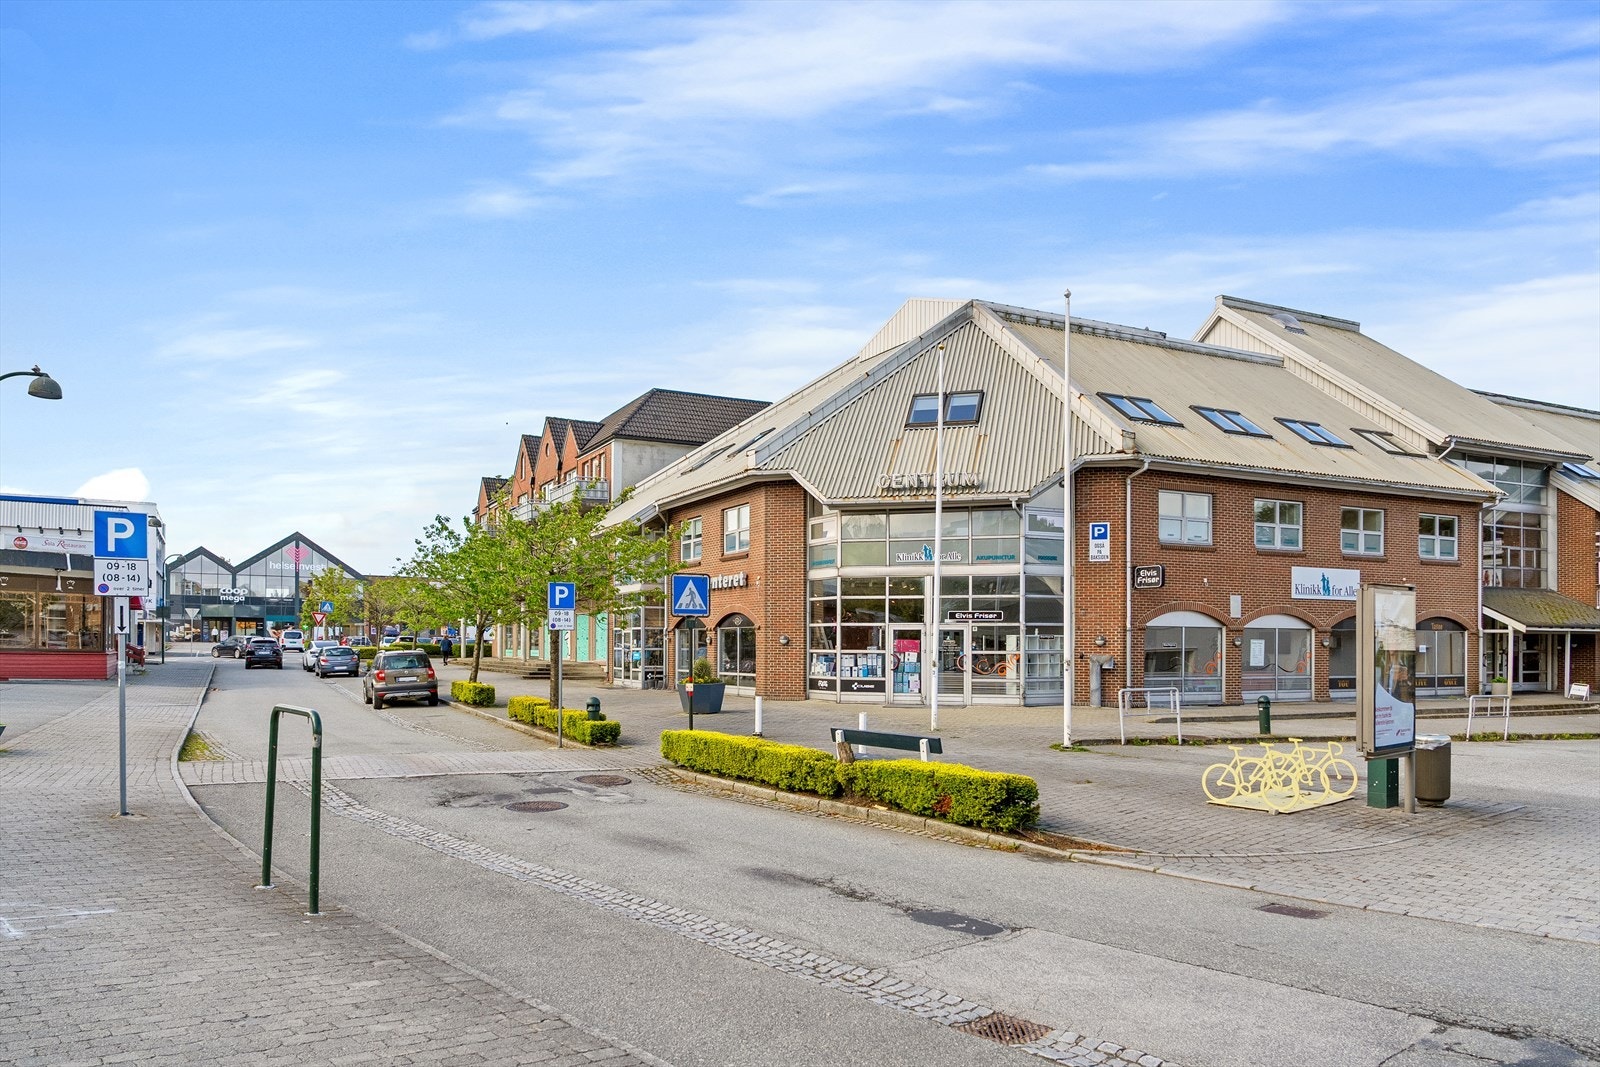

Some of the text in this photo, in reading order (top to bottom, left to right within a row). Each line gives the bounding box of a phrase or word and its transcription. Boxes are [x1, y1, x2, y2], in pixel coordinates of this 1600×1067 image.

[107, 517, 135, 552] P
[1094, 527, 1104, 537] P
[711, 572, 746, 588] nteret
[220, 587, 248, 596] coop
[555, 586, 569, 606] P
[1295, 583, 1321, 595] Klinikk
[1331, 585, 1342, 596] for
[220, 595, 246, 603] mega
